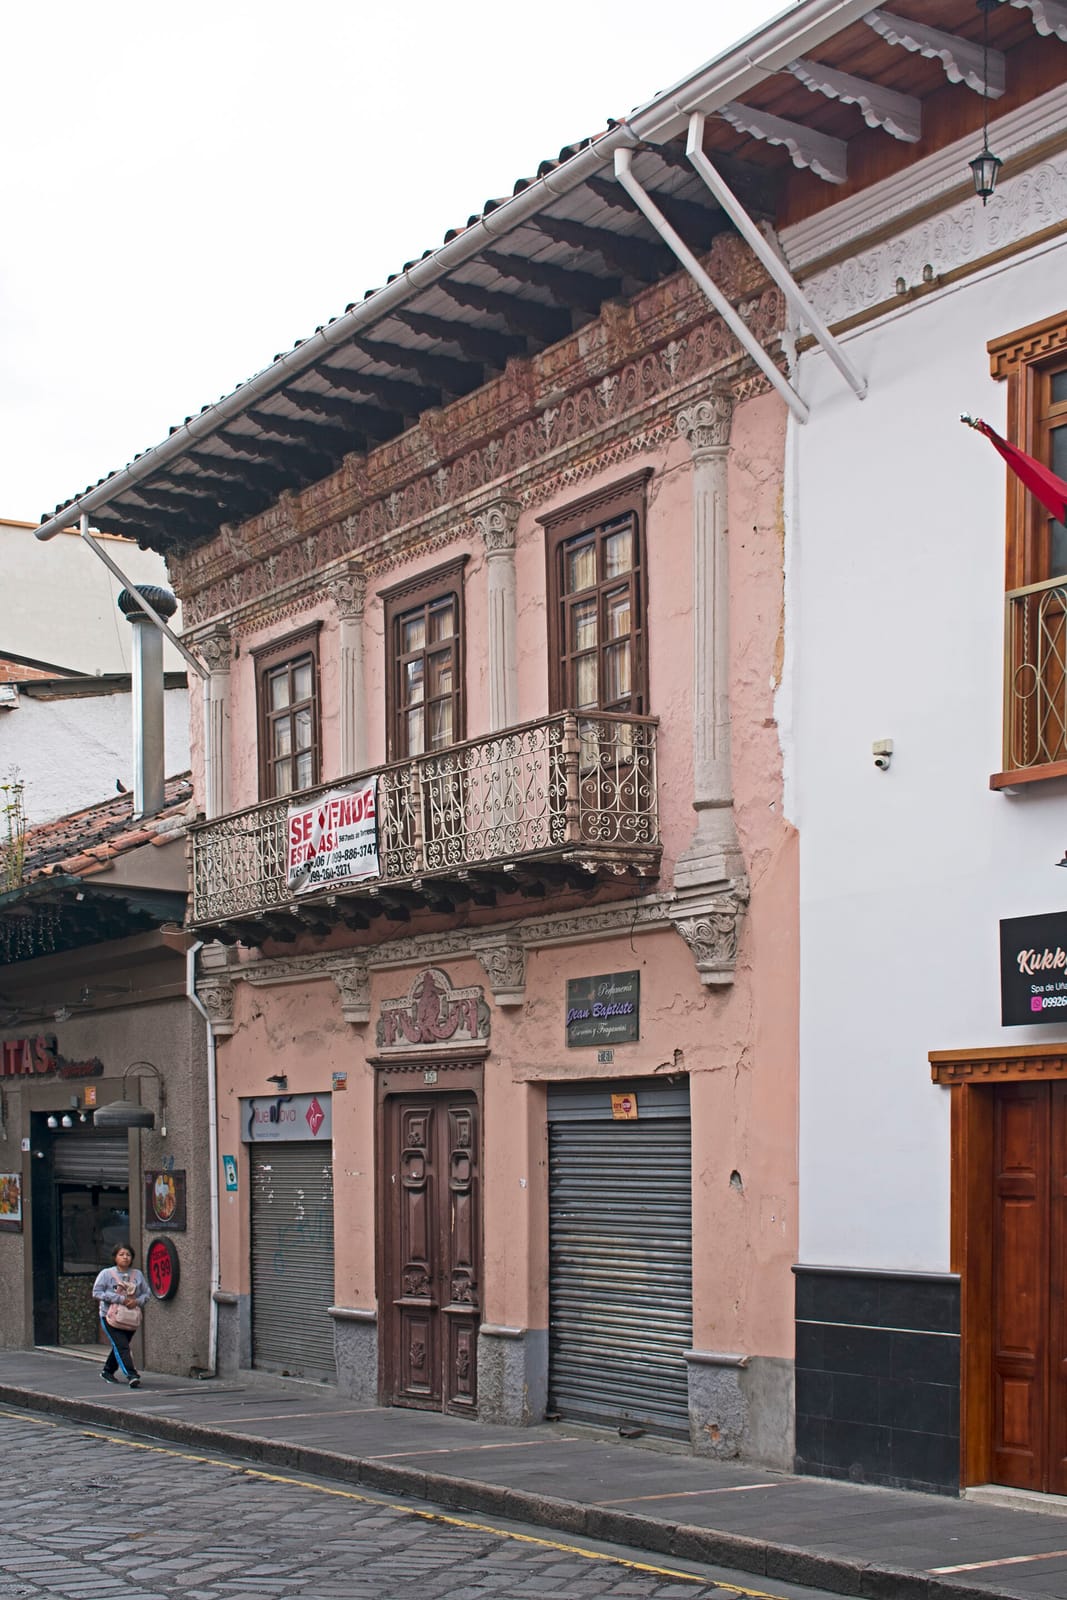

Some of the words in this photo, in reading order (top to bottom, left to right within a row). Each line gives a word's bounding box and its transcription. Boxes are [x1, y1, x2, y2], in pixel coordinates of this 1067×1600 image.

[291, 812, 312, 845] SE
[291, 843, 316, 867] ESTA
[318, 832, 339, 853] ASA
[1017, 947, 1067, 976] Kukk
[1030, 984, 1045, 995] Spa
[1046, 983, 1055, 992] de
[567, 1008, 590, 1026] Jean
[592, 1001, 633, 1020] Baptiste
